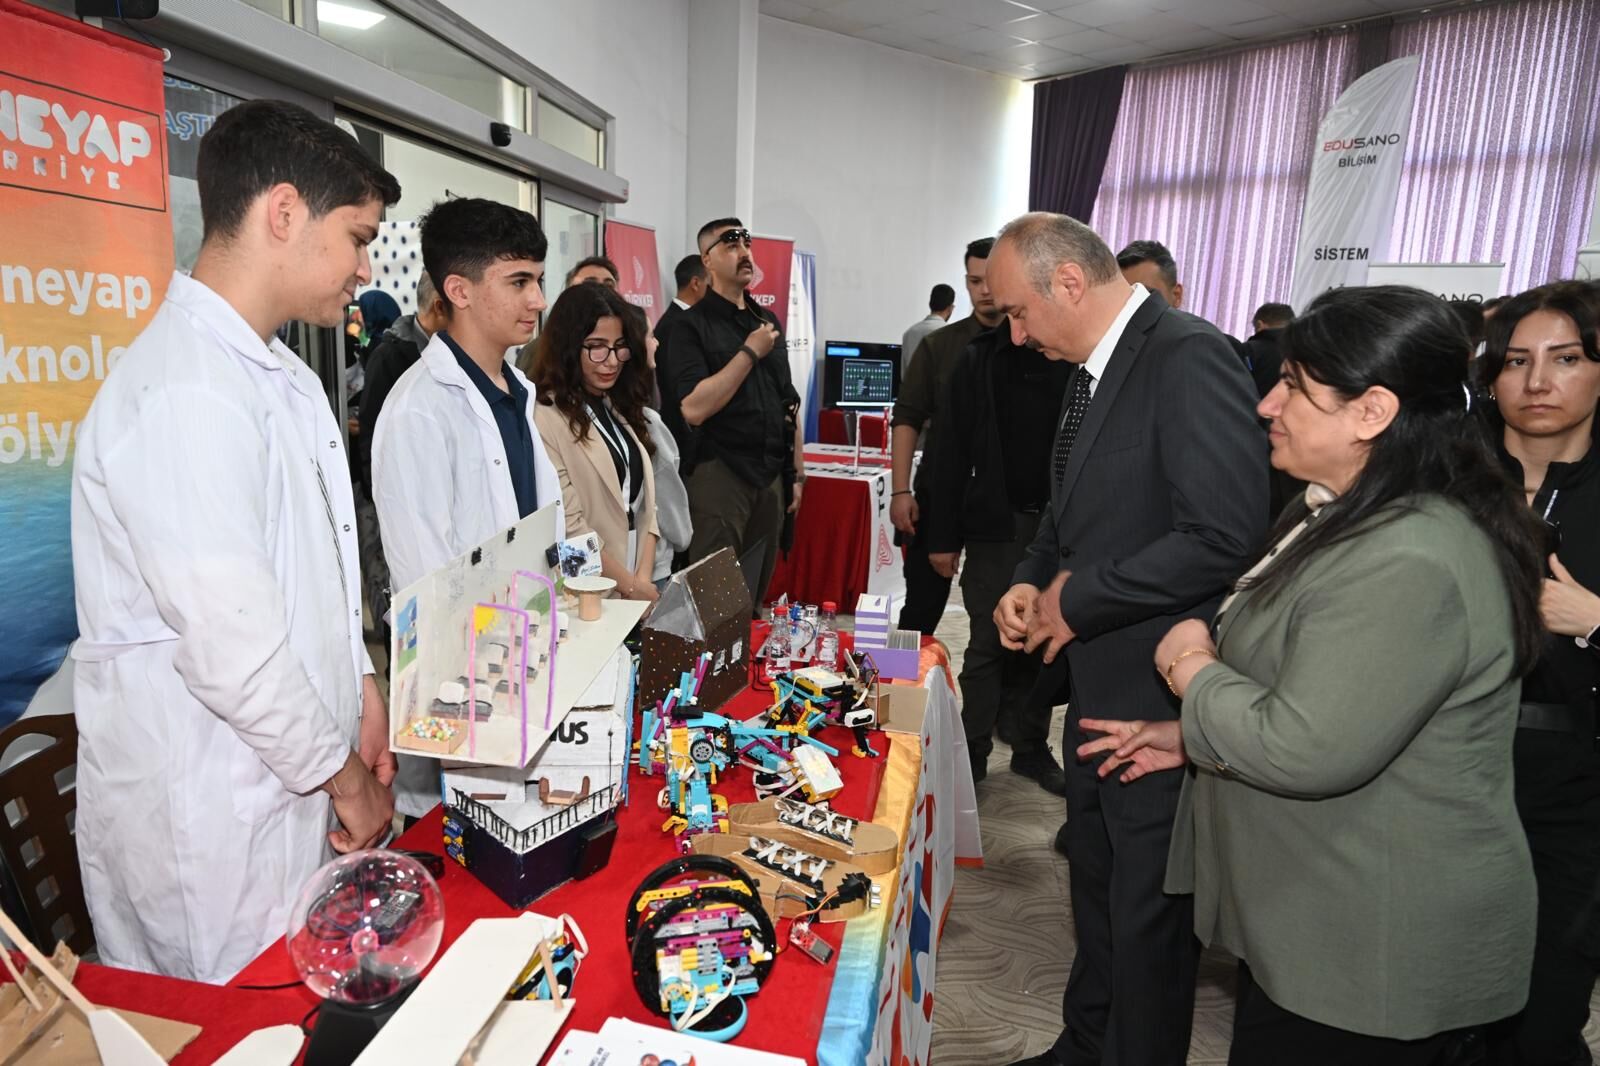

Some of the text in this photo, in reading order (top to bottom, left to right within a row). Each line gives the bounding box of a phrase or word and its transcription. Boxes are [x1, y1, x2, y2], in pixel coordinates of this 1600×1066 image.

[1323, 133, 1400, 152] EDUSANO
[1338, 153, 1377, 168] BİLİŞİM
[1314, 244, 1369, 261] SİSTEM
[0, 411, 81, 467] öly
